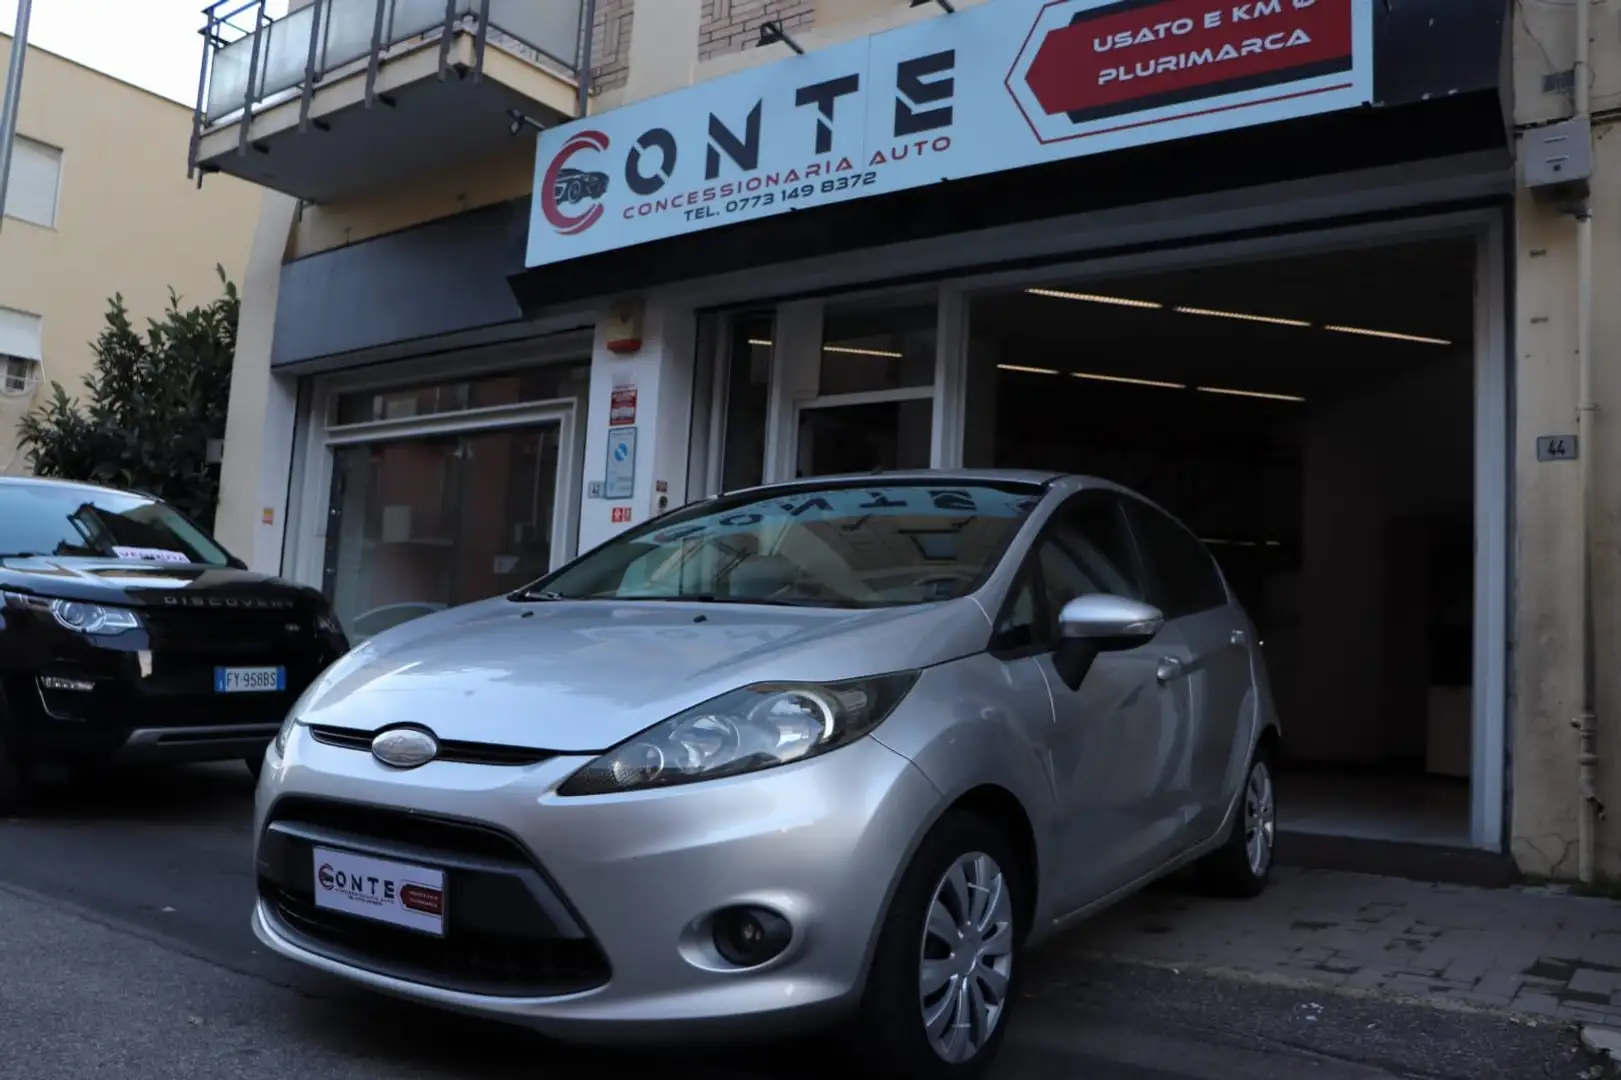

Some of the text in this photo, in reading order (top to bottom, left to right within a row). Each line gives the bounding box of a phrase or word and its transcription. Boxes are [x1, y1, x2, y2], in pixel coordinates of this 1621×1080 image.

[1093, 18, 1194, 52] USATO
[1204, 10, 1222, 29] E
[1232, 0, 1282, 22] KM
[1098, 28, 1312, 85] PLURIMARCA
[541, 49, 956, 236] CONTE
[623, 136, 951, 220] CONCESSIONARIA AUTO
[684, 171, 877, 222] TEL. 0773 149 8372
[1548, 439, 1566, 457] 44
[163, 595, 295, 609] DISCOVERY
[227, 671, 240, 687] FY
[319, 863, 395, 899] CONTE
